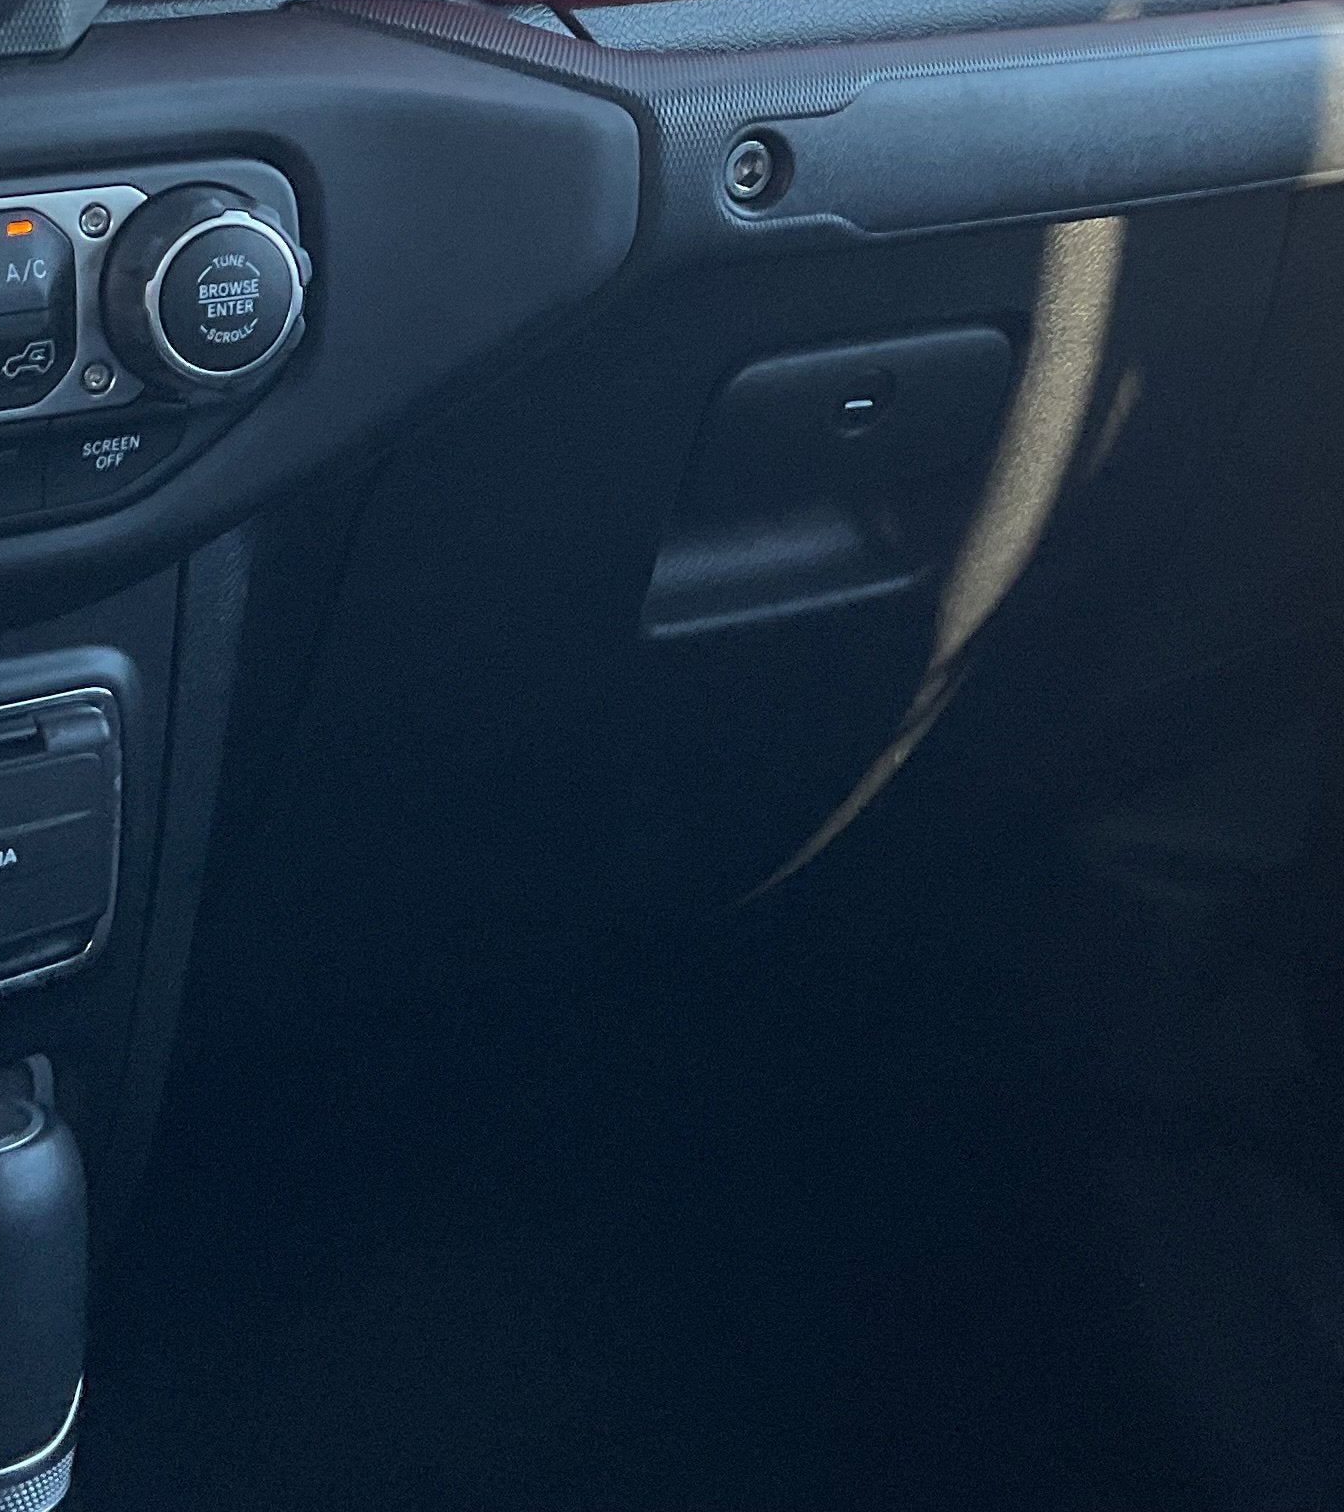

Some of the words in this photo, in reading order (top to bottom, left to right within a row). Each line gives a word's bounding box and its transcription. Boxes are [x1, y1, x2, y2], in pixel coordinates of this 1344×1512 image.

[6, 259, 48, 284] A/C
[212, 254, 246, 269] TUNE
[199, 278, 260, 300] BROWSE
[207, 299, 255, 319] ENTER
[206, 324, 254, 344] SCROLL
[82, 433, 141, 460] SCREEN
[95, 451, 126, 473] OFF
